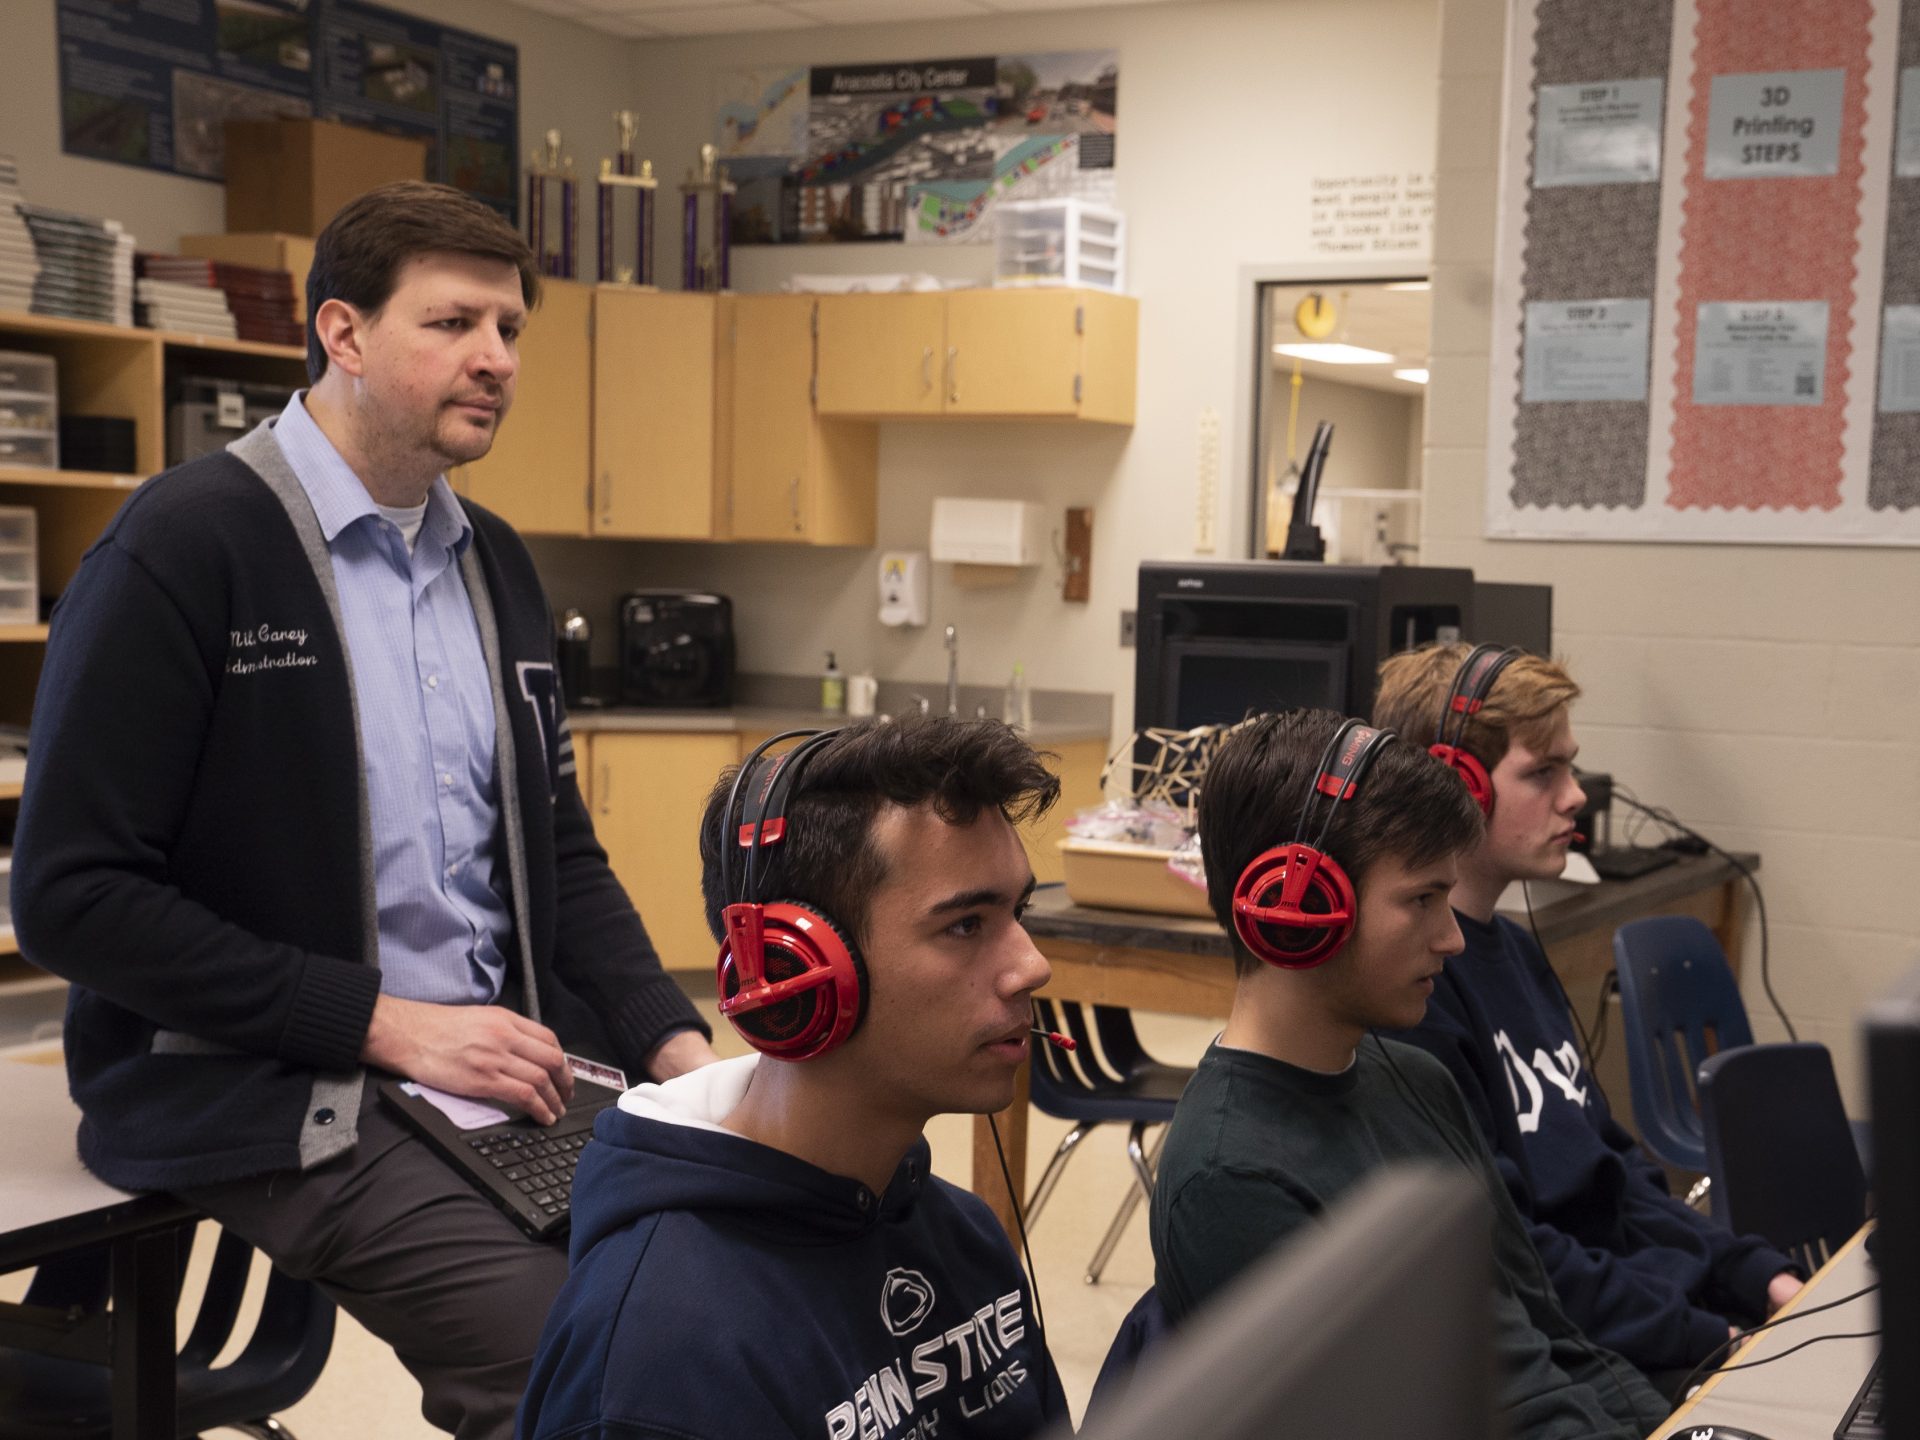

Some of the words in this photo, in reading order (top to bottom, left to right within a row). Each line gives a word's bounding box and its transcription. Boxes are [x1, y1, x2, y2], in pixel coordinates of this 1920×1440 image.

[896, 70, 921, 91] City
[924, 67, 969, 88] Center
[1581, 88, 1608, 102] STEP
[1761, 86, 1791, 107] 3D
[1733, 116, 1815, 139] Printing
[1741, 143, 1801, 164] STEPS
[825, 1357, 914, 1440] PENN
[911, 1289, 1026, 1400] STATE
